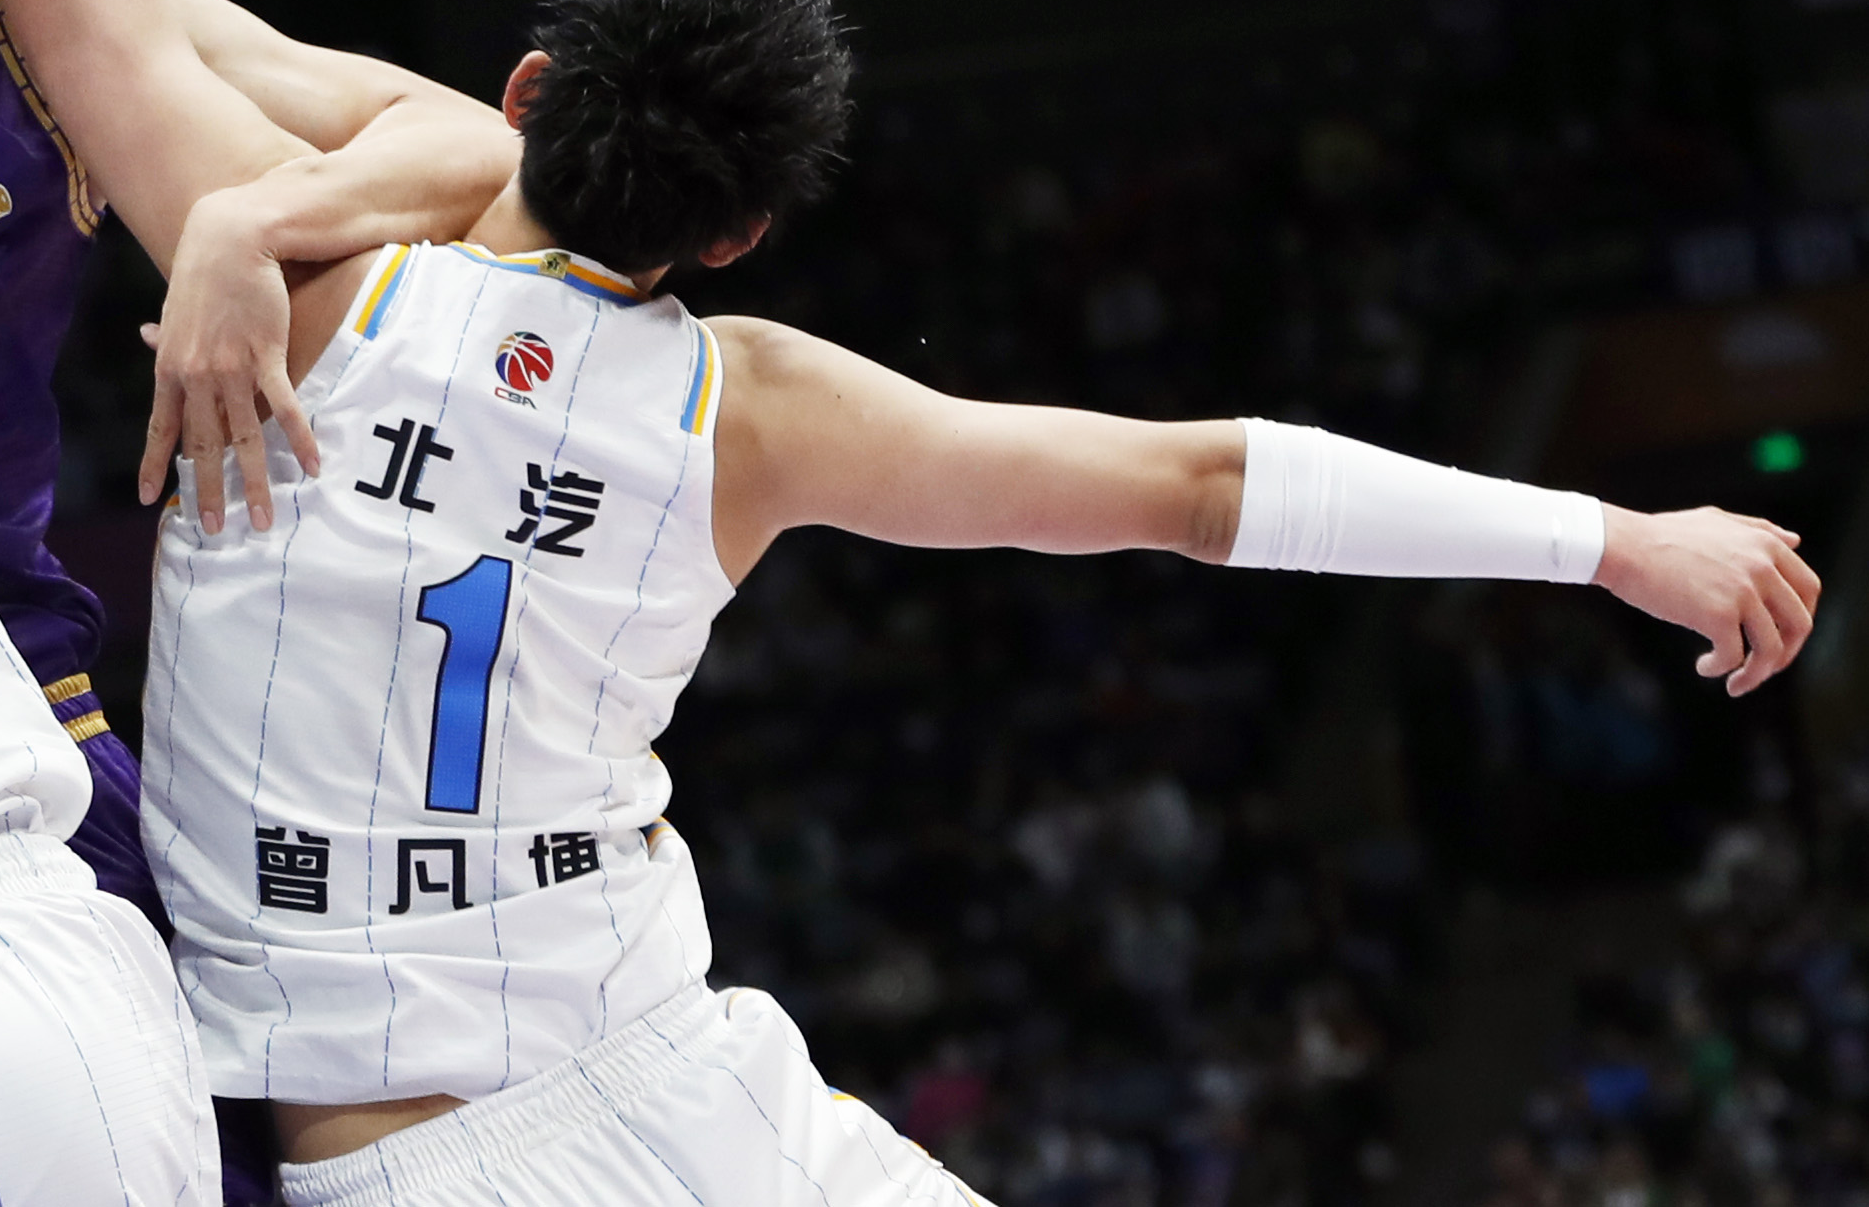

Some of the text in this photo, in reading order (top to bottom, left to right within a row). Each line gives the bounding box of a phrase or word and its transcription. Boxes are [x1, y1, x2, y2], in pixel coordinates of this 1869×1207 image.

[494, 386, 537, 410] CBA
[355, 417, 605, 558] 北汽
[416, 554, 514, 814] 1
